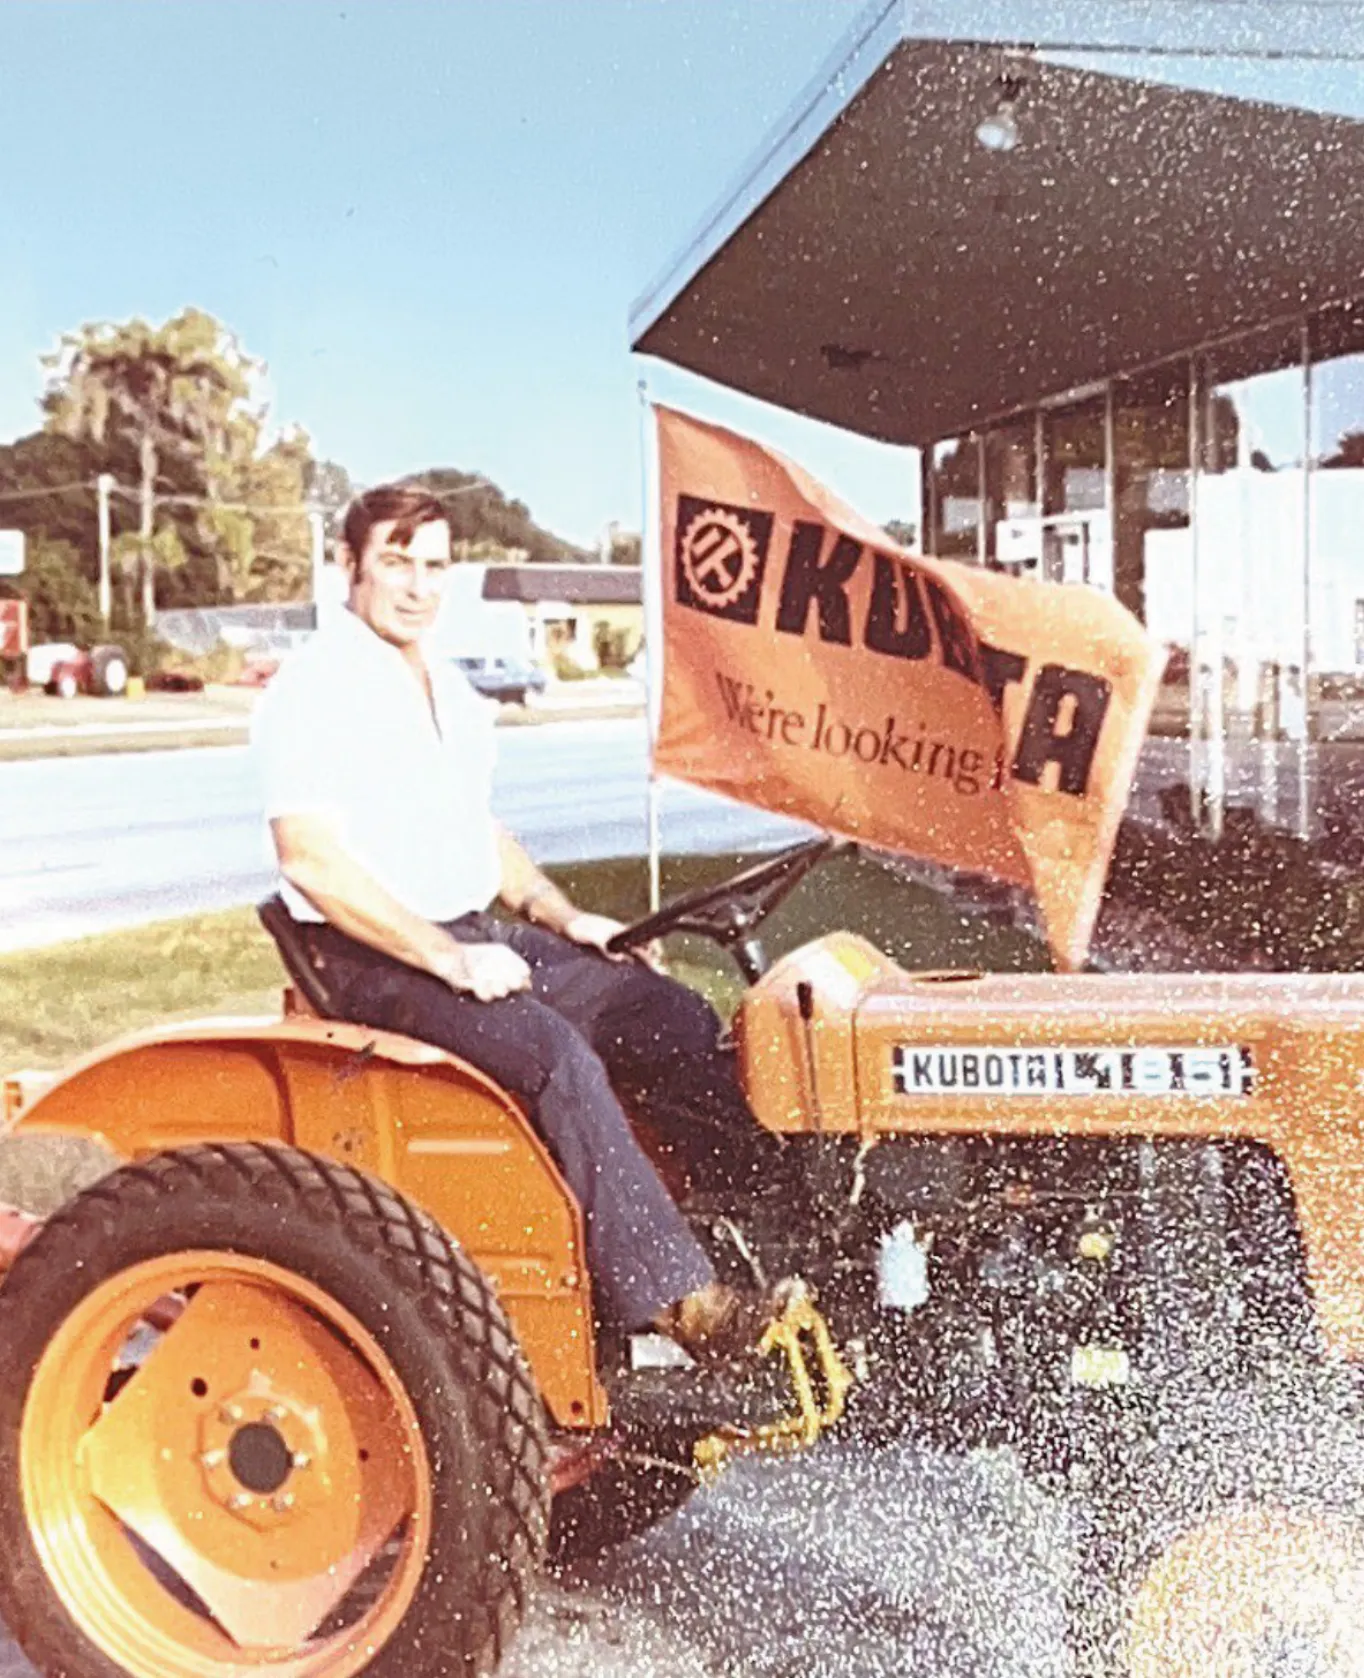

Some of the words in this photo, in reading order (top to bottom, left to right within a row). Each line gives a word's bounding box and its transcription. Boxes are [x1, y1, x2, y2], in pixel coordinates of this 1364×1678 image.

[716, 672, 805, 744] We're
[815, 703, 984, 794] looking
[913, 1053, 1046, 1088] KUBOTA
